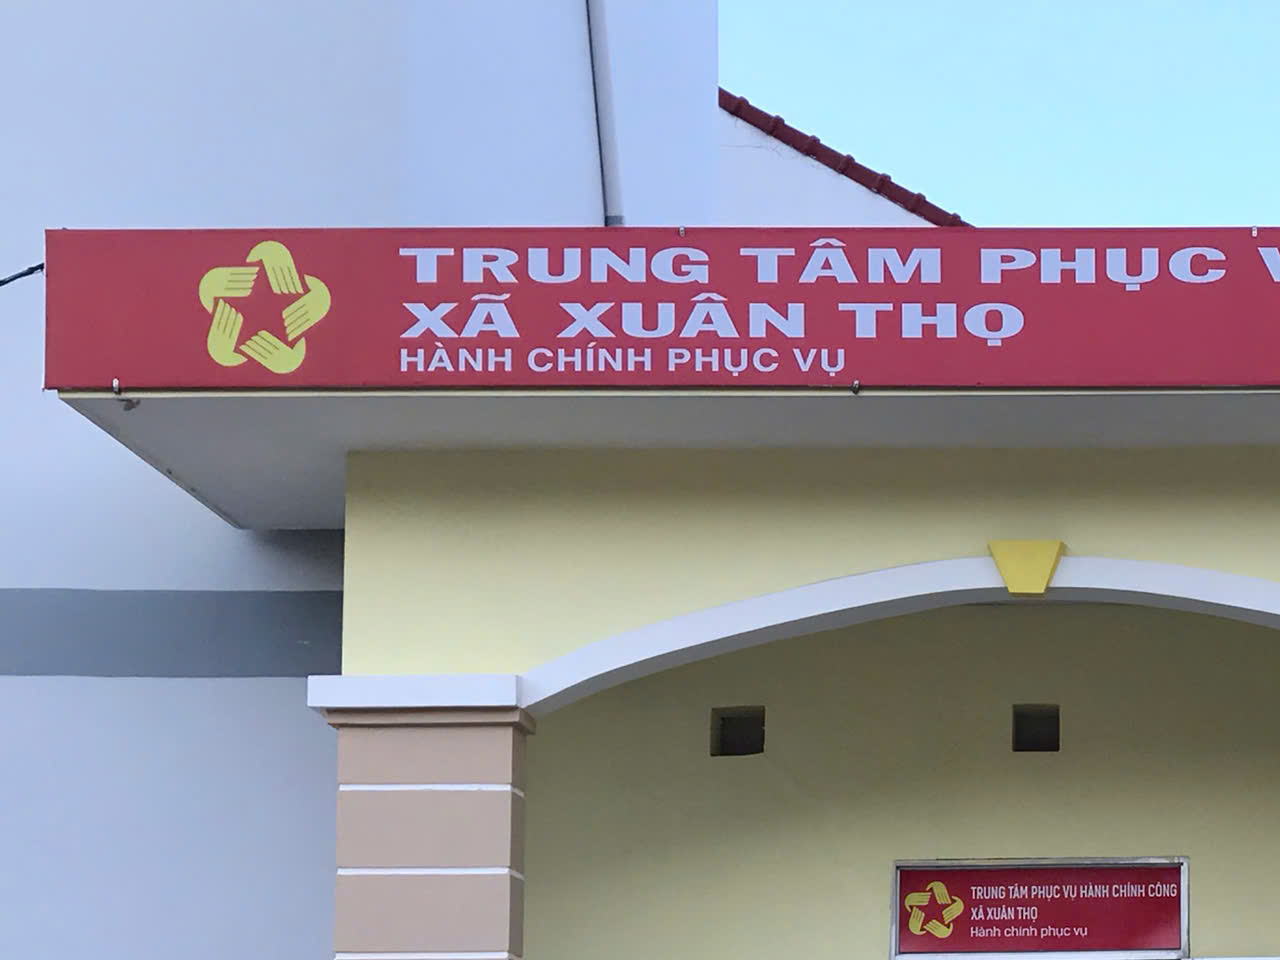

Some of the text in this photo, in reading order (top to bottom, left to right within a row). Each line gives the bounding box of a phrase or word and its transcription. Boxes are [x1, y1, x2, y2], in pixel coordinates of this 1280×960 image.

[399, 247, 709, 285] TRUNG
[740, 238, 942, 284] TÂM
[981, 247, 1227, 292] PHỤC
[400, 294, 1025, 350] XÃ XUÂN THỌ
[401, 342, 846, 377] HÀNH CHÍNH PHỤC VỤ
[971, 881, 1178, 902] TRUNG TÂM PHỤC VỤ HÀNH CHÍNH CÔNG
[970, 904, 1039, 923] XÃ XUÂN THỌ
[970, 926, 1088, 939] Hành chính phục vụ
